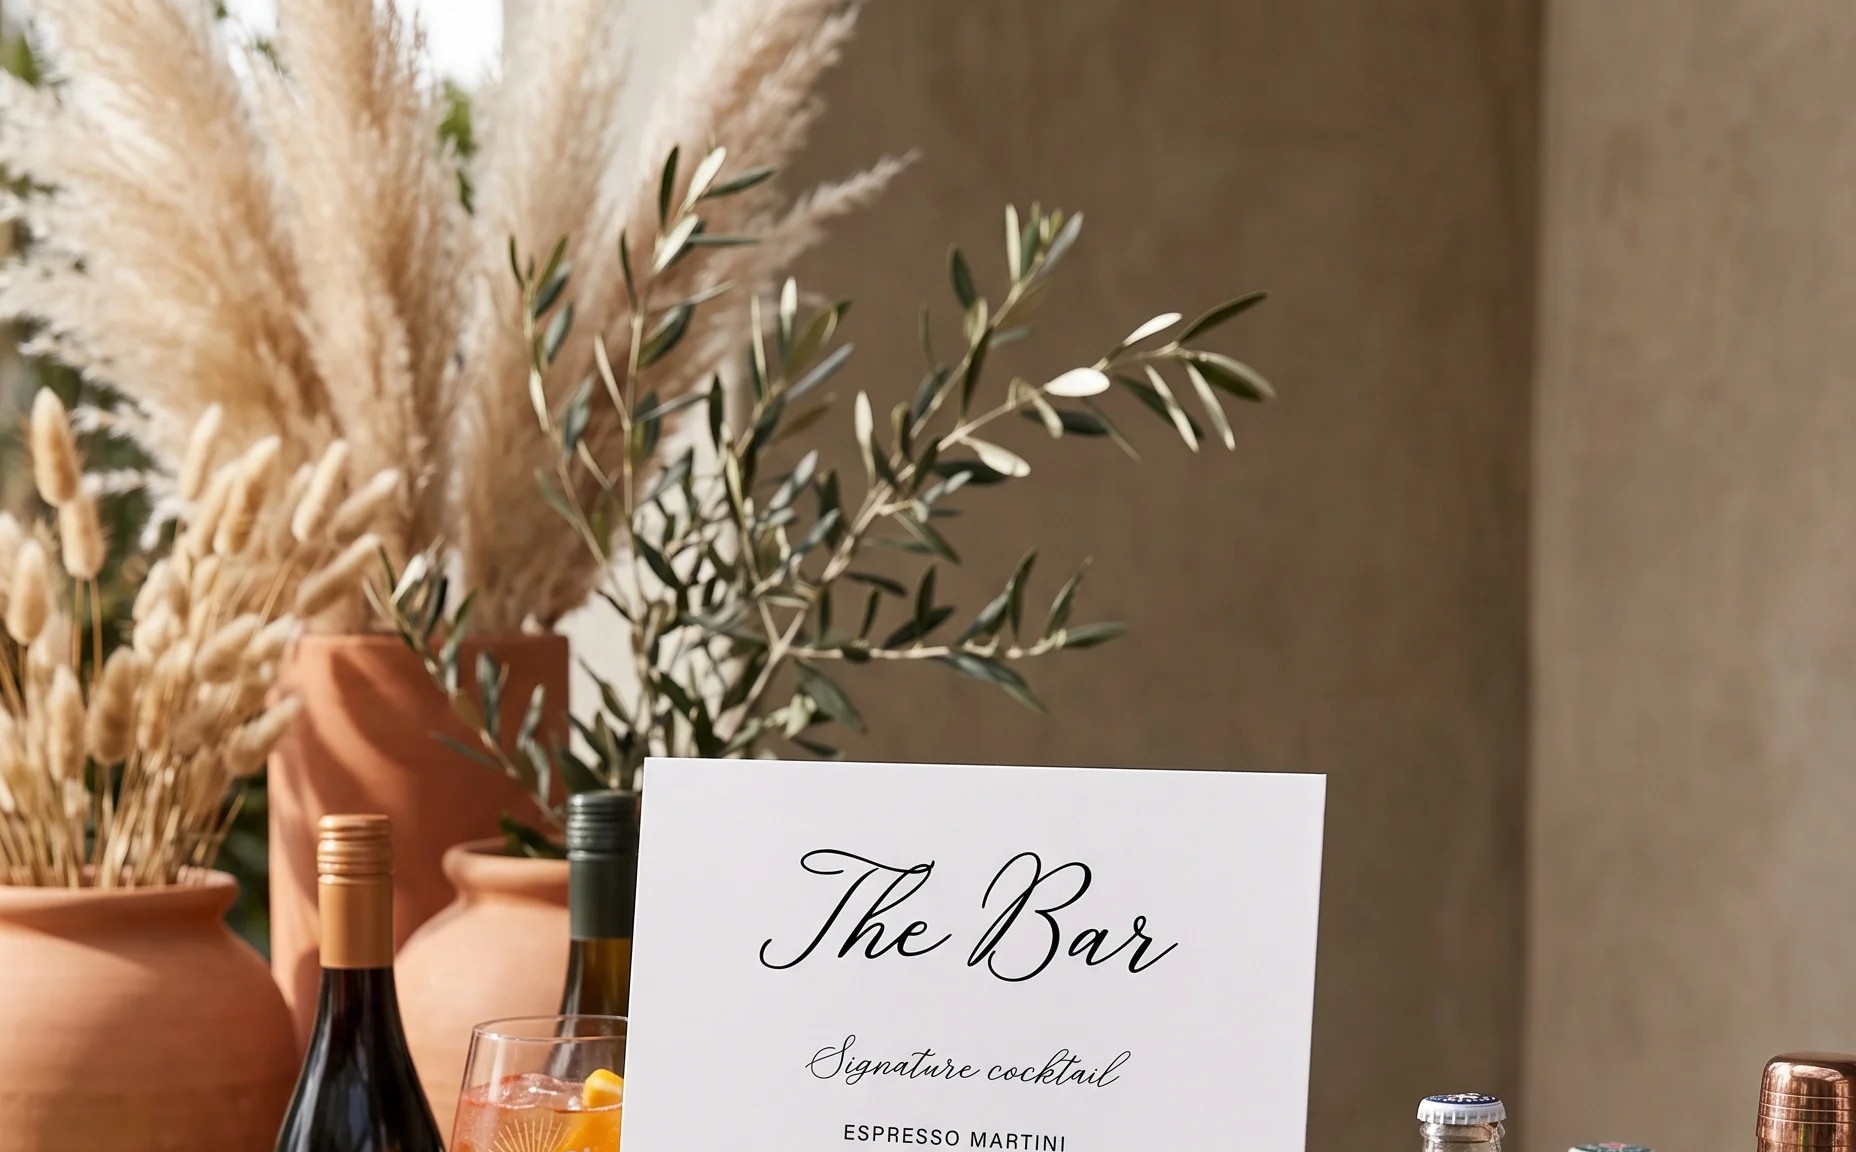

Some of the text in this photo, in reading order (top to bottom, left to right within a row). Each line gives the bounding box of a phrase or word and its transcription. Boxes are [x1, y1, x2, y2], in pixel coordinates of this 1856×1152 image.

[758, 848, 1179, 983] The Bar
[804, 1033, 1132, 1088] Signature cocktail
[843, 1123, 1065, 1152] ESPRESSO MARTINI
